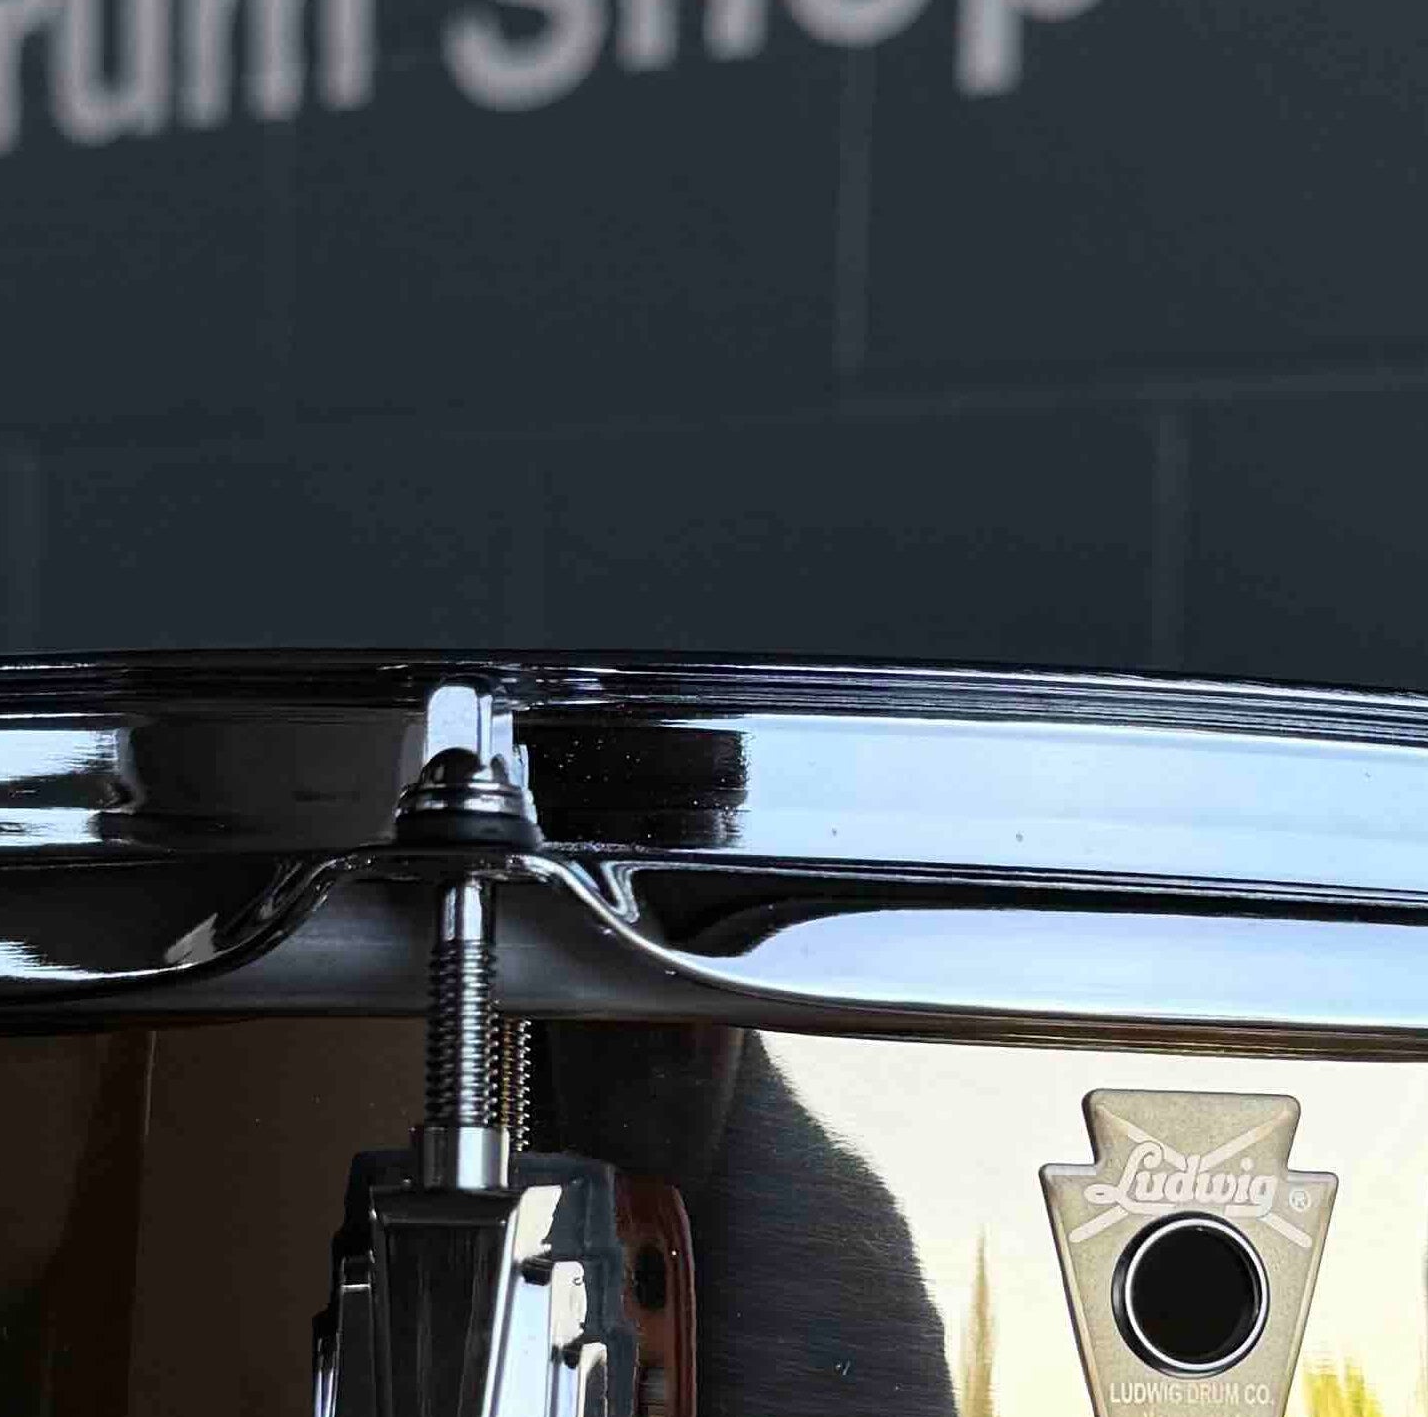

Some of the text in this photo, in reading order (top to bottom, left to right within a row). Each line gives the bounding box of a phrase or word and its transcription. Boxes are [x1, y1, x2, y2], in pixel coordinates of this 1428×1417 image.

[1083, 1140, 1278, 1217] Ludwig
[1109, 1381, 1184, 1405] LUDWIG
[1186, 1382, 1240, 1406] DRUM
